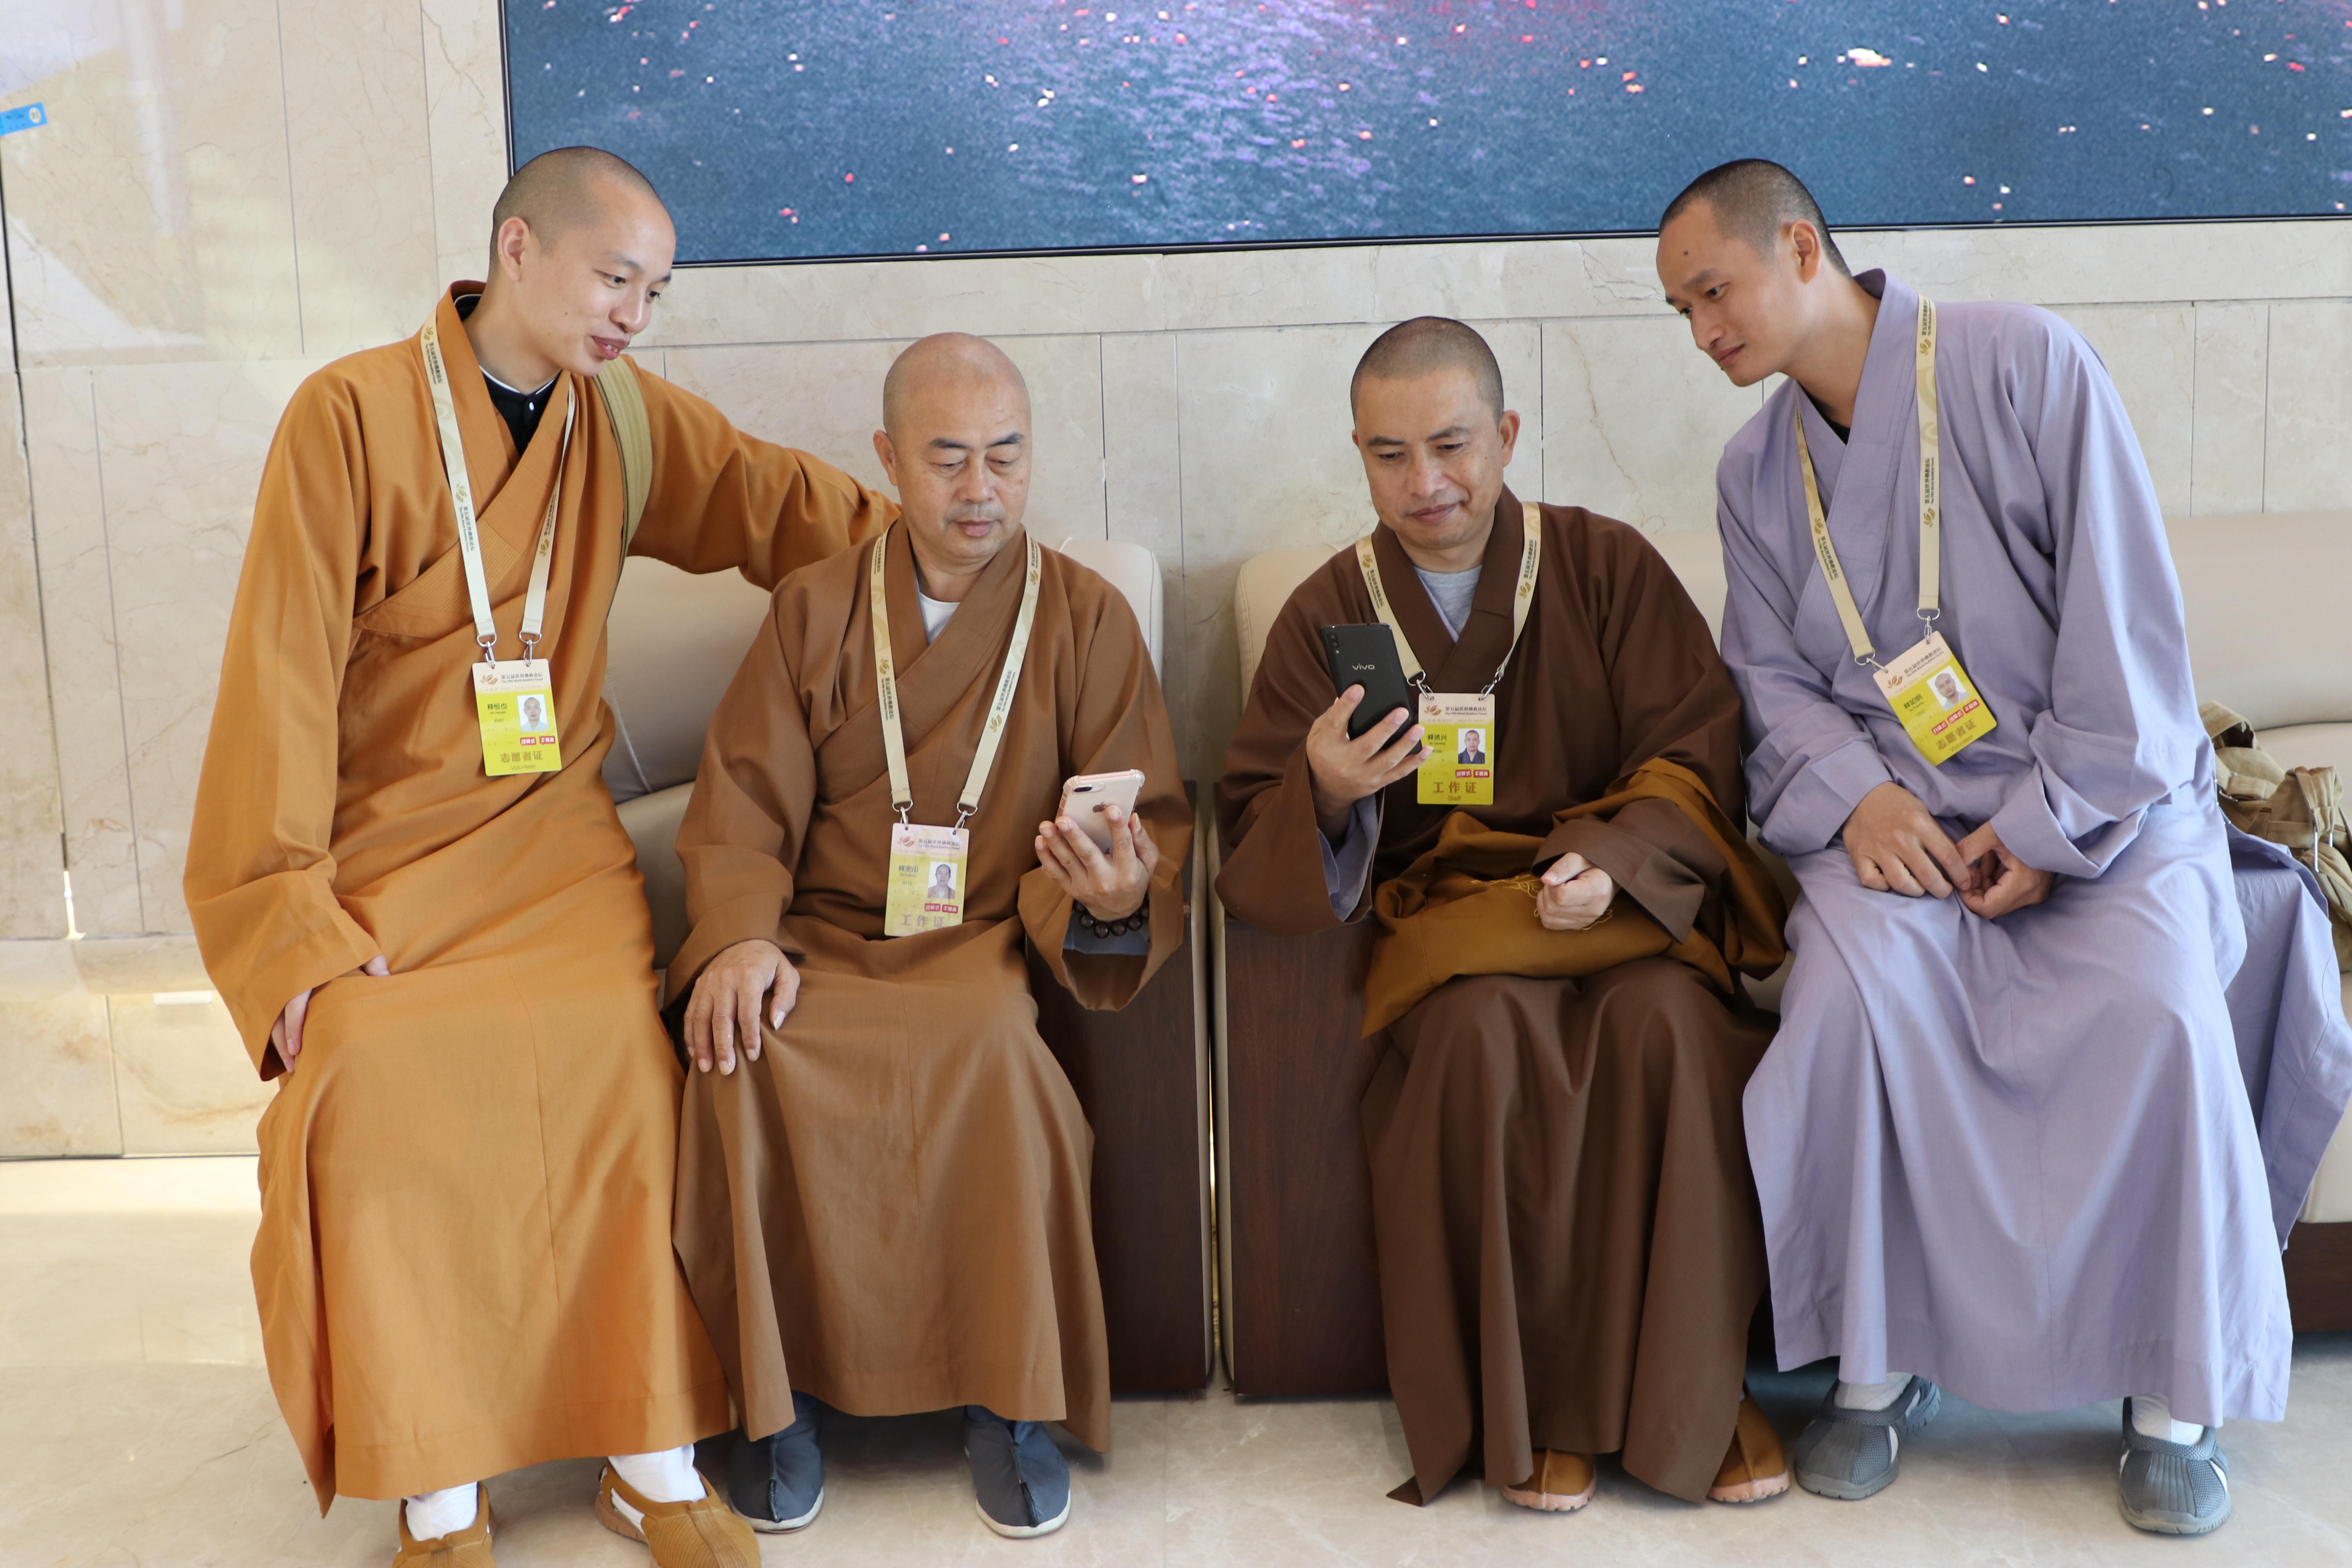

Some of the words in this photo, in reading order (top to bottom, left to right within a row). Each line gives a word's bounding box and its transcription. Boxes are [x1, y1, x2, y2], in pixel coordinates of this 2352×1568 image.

[429, 342, 442, 383] 第五届世界佛教论坛
[463, 506, 475, 551] 第五届世界佛教论坛
[1524, 539, 1533, 578] 第五届世界佛教论坛
[1821, 536, 1838, 578] 第五届世界佛教论坛
[1370, 569, 1384, 606] 第五届世界佛教论坛
[1904, 646, 1941, 674] 第五届世界佛教论坛
[886, 677, 894, 719] 第五届世界佛教论坛
[996, 670, 1012, 710] 第五届世界佛教论坛
[1936, 719, 1976, 750] 志愿者证
[1949, 733, 1974, 752] Volunteer
[501, 751, 542, 762] 志愿者证
[1433, 781, 1476, 793] 工作证
[901, 915, 944, 927] 工作证
